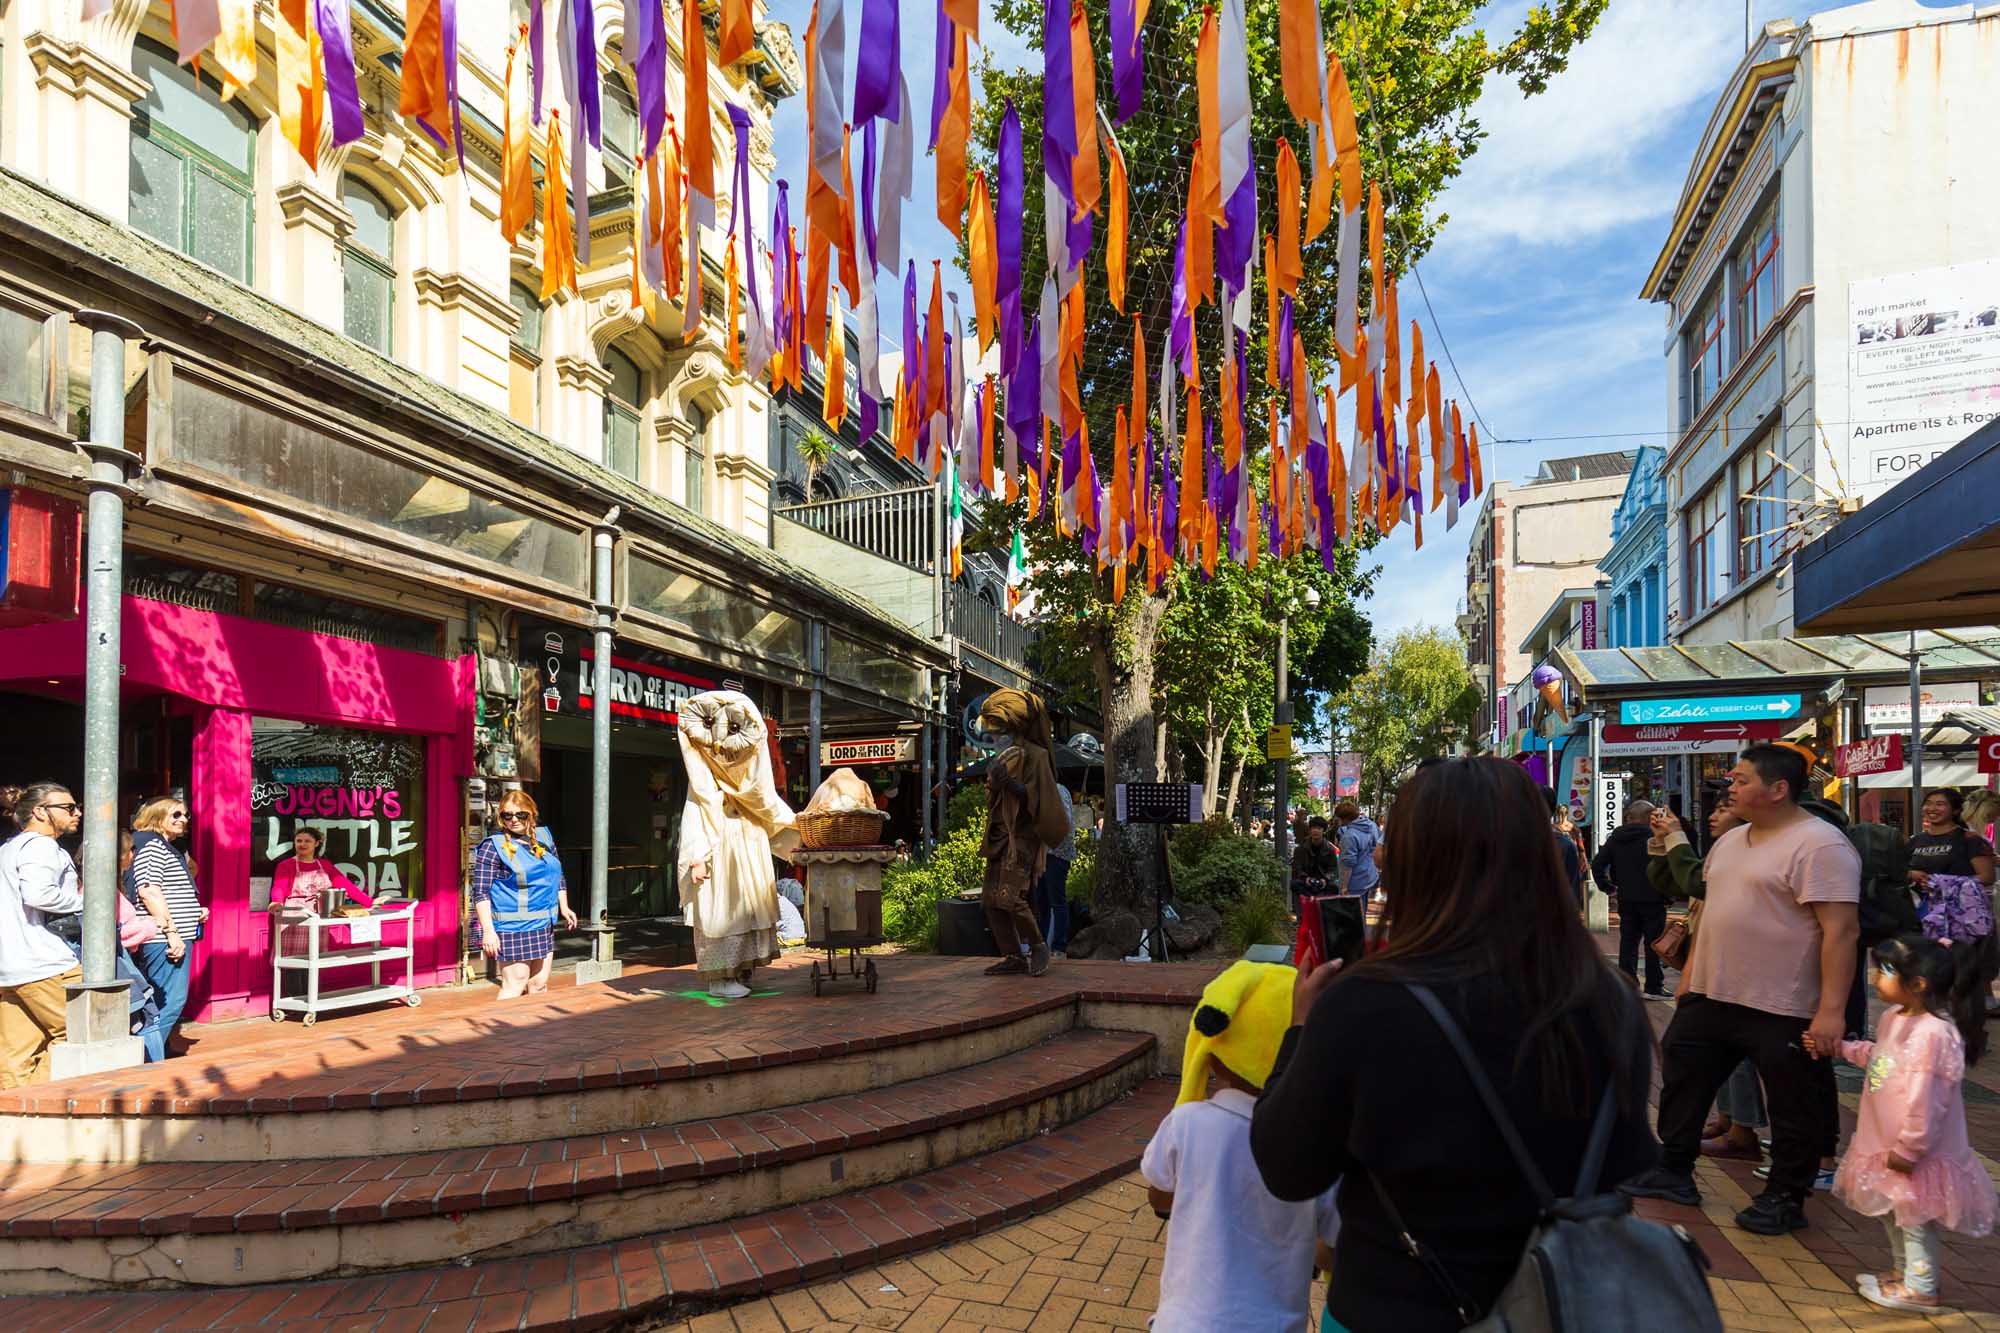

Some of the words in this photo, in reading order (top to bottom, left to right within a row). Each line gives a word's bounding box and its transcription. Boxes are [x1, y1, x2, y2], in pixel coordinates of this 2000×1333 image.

[1888, 299, 1927, 311] market
[1854, 417, 1941, 439] Apartments
[1877, 453, 1923, 473] FOR
[579, 660, 643, 704] LRD
[647, 677, 661, 693] OF
[644, 690, 664, 709] THE
[830, 746, 857, 759] LORD
[867, 744, 896, 757] FRIES
[1606, 781, 1616, 831] BOOKS
[266, 816, 418, 862] LTTLE
[334, 861, 402, 897] DIA
